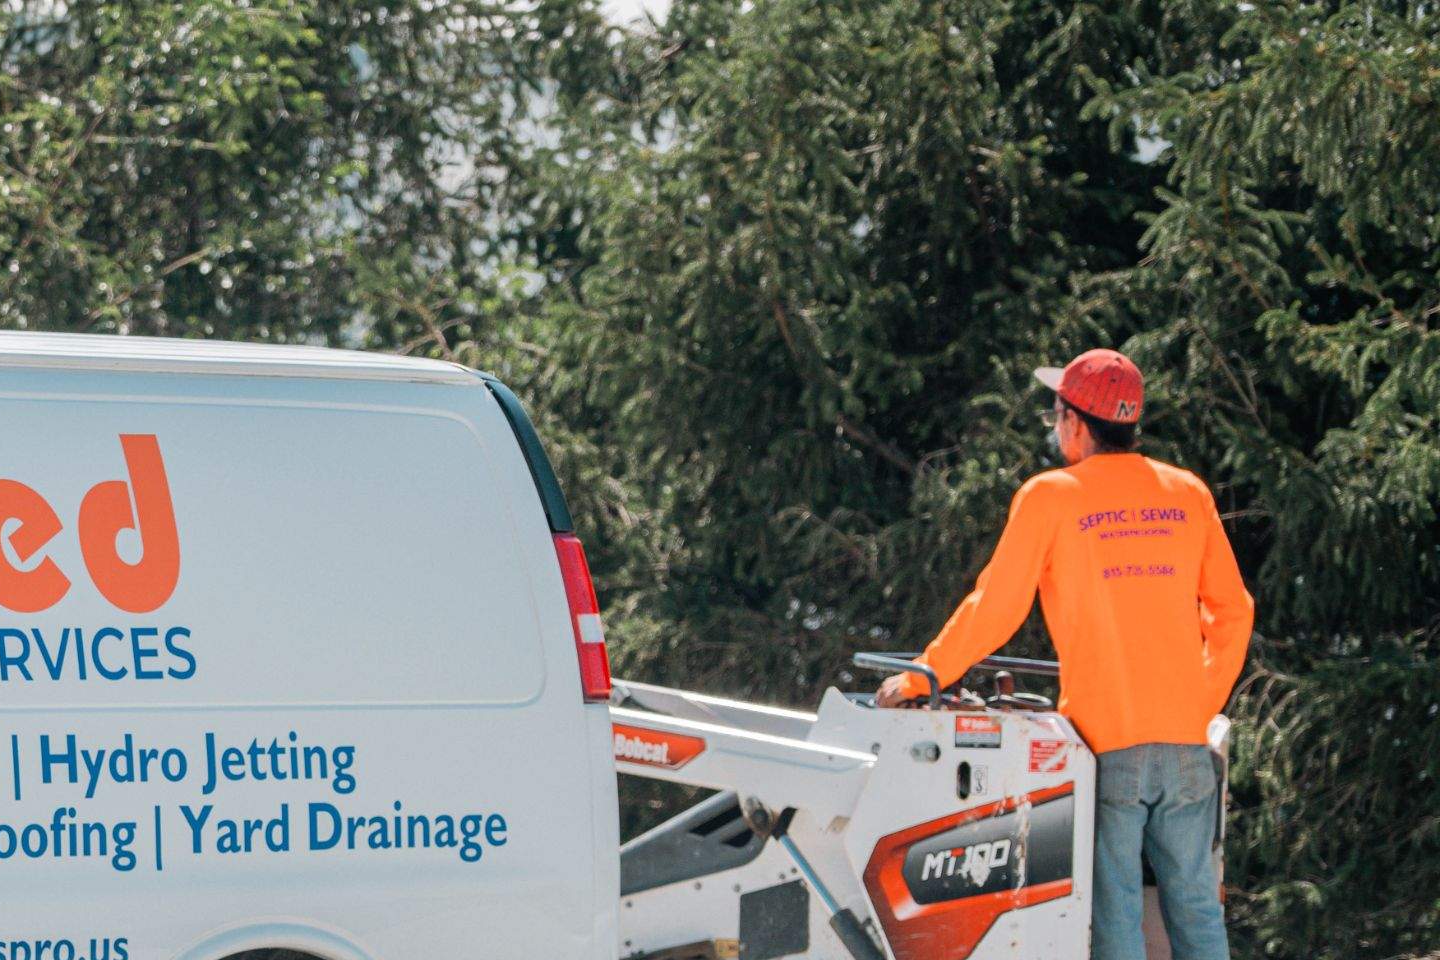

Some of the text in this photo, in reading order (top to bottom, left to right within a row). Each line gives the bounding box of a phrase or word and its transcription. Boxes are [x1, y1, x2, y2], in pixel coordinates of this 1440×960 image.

[1079, 510, 1127, 531] SEPTIC
[1140, 508, 1187, 522] SEWER
[40, 733, 188, 799] Hydro
[202, 730, 357, 796] Jetting
[615, 732, 669, 764] Bobcat
[179, 803, 290, 854] Yard
[308, 799, 508, 863] Drainage
